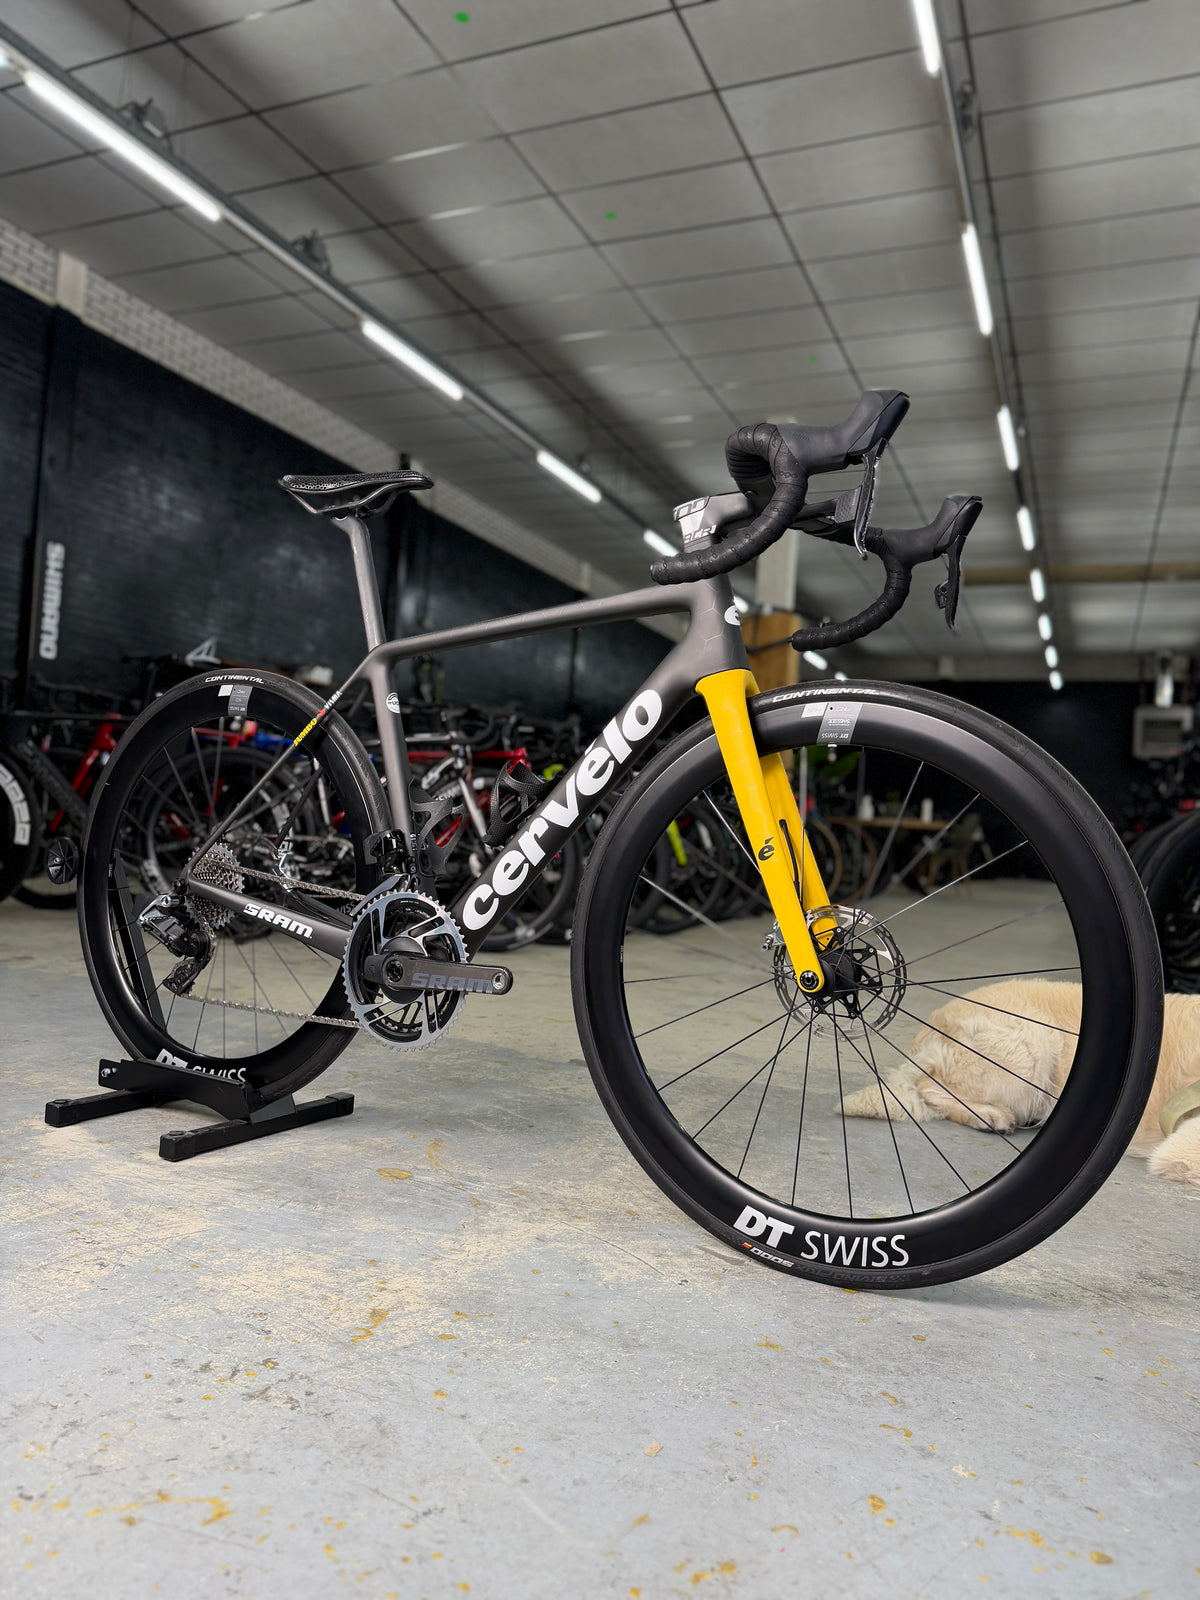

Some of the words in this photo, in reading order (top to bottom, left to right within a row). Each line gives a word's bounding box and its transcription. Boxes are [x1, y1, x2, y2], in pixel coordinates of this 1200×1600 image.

[39, 541, 65, 660] SHIMANO
[205, 674, 264, 685] CONTINENTAL
[772, 687, 880, 703] CONTINENTAL
[293, 718, 317, 747] JUMBO
[324, 690, 343, 709] VISMA
[463, 689, 662, 931] cervélo
[243, 903, 313, 939] SRAM
[411, 972, 494, 995] SRAM
[733, 1205, 795, 1248] DT
[800, 1230, 909, 1267] SWISS
[750, 1246, 795, 1268] 5000
